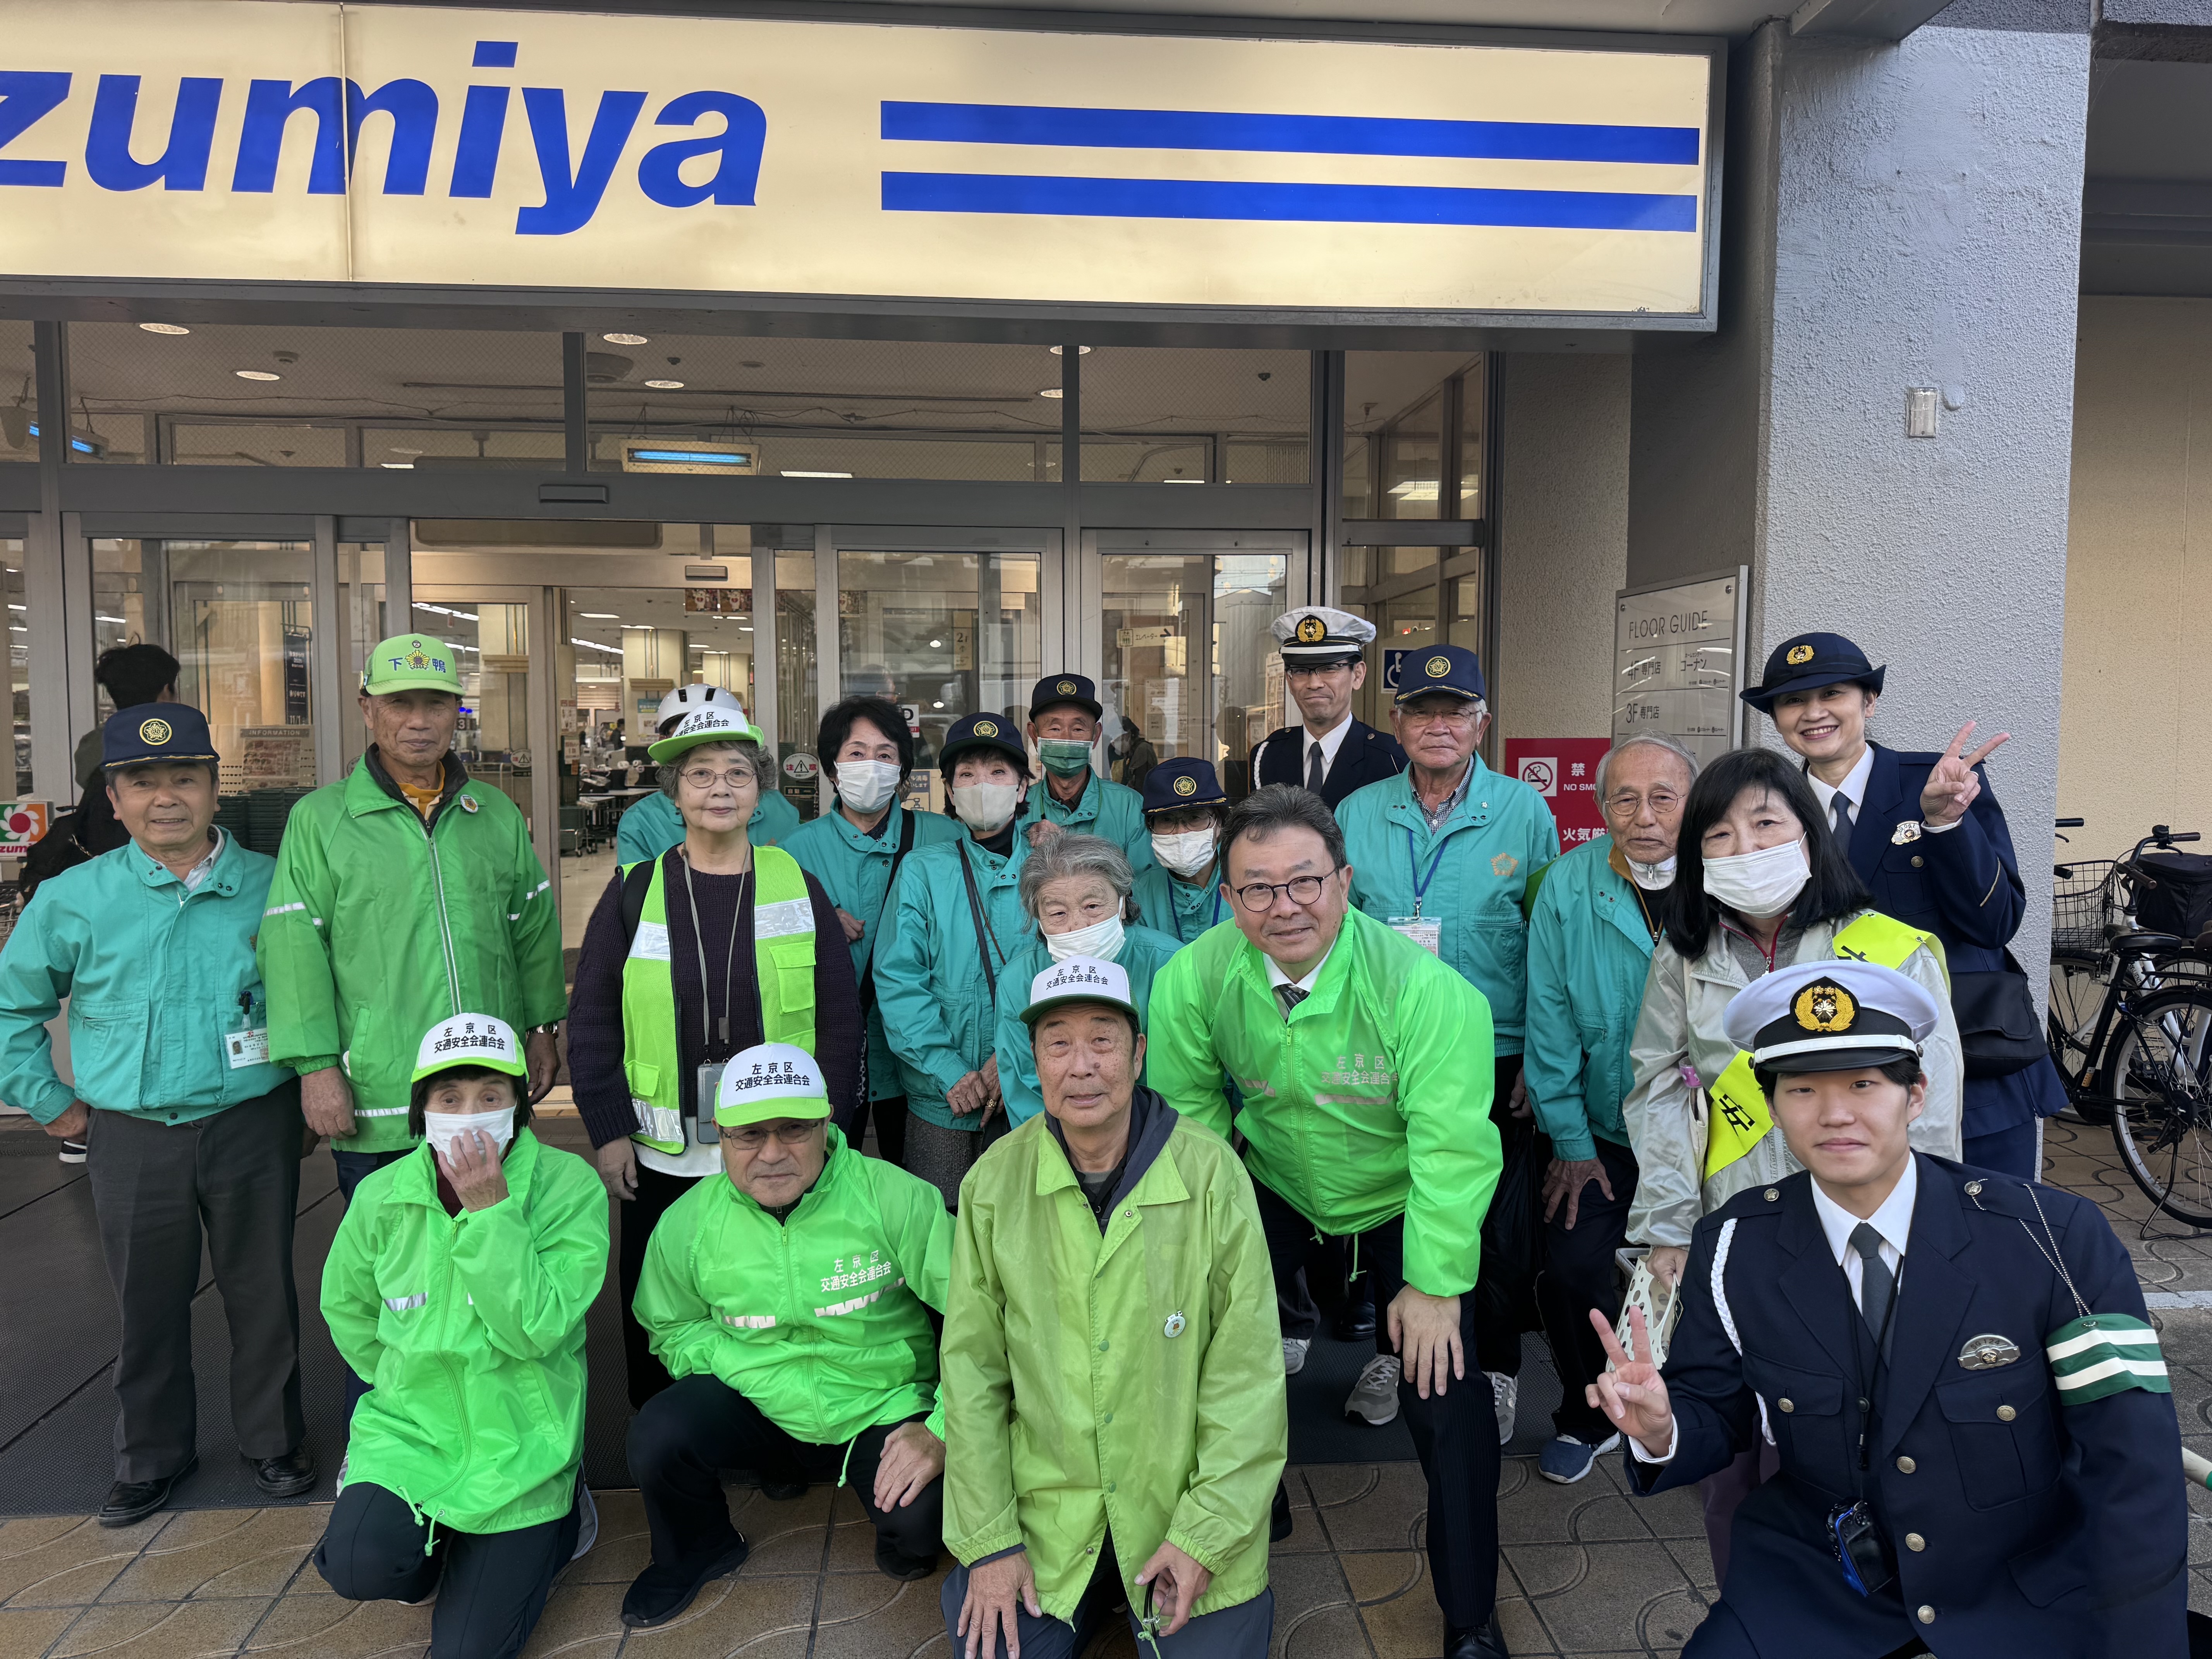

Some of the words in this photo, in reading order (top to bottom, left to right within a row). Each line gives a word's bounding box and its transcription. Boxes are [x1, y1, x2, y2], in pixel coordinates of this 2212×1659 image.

[0, 40, 767, 235] zumiya
[1629, 617, 1665, 639] FLOOR
[1670, 610, 1708, 634] GUIDE
[1627, 660, 1640, 680] 4F
[1642, 661, 1661, 675] 専門店
[1680, 658, 1707, 672] コーナン
[1626, 703, 1638, 723] 3F
[1640, 705, 1660, 719] 専門店
[458, 719, 465, 729] 3
[1571, 763, 1585, 776] 禁
[1563, 827, 1608, 842] 火気厳
[0, 843, 32, 853] zum
[1057, 965, 1096, 977] 左京区
[1046, 973, 1109, 990] 交通安全会連合会
[443, 1022, 496, 1037] 左京区
[434, 1035, 505, 1054] 交通安全会連合会
[752, 1061, 793, 1075] 左京区
[1336, 1053, 1384, 1070] 左京区
[735, 1073, 810, 1092] 交通安全会連合会
[834, 1249, 879, 1273] 左京区
[820, 1261, 891, 1293] 交通安全会連合会
[1970, 1341, 1981, 1350] SG
